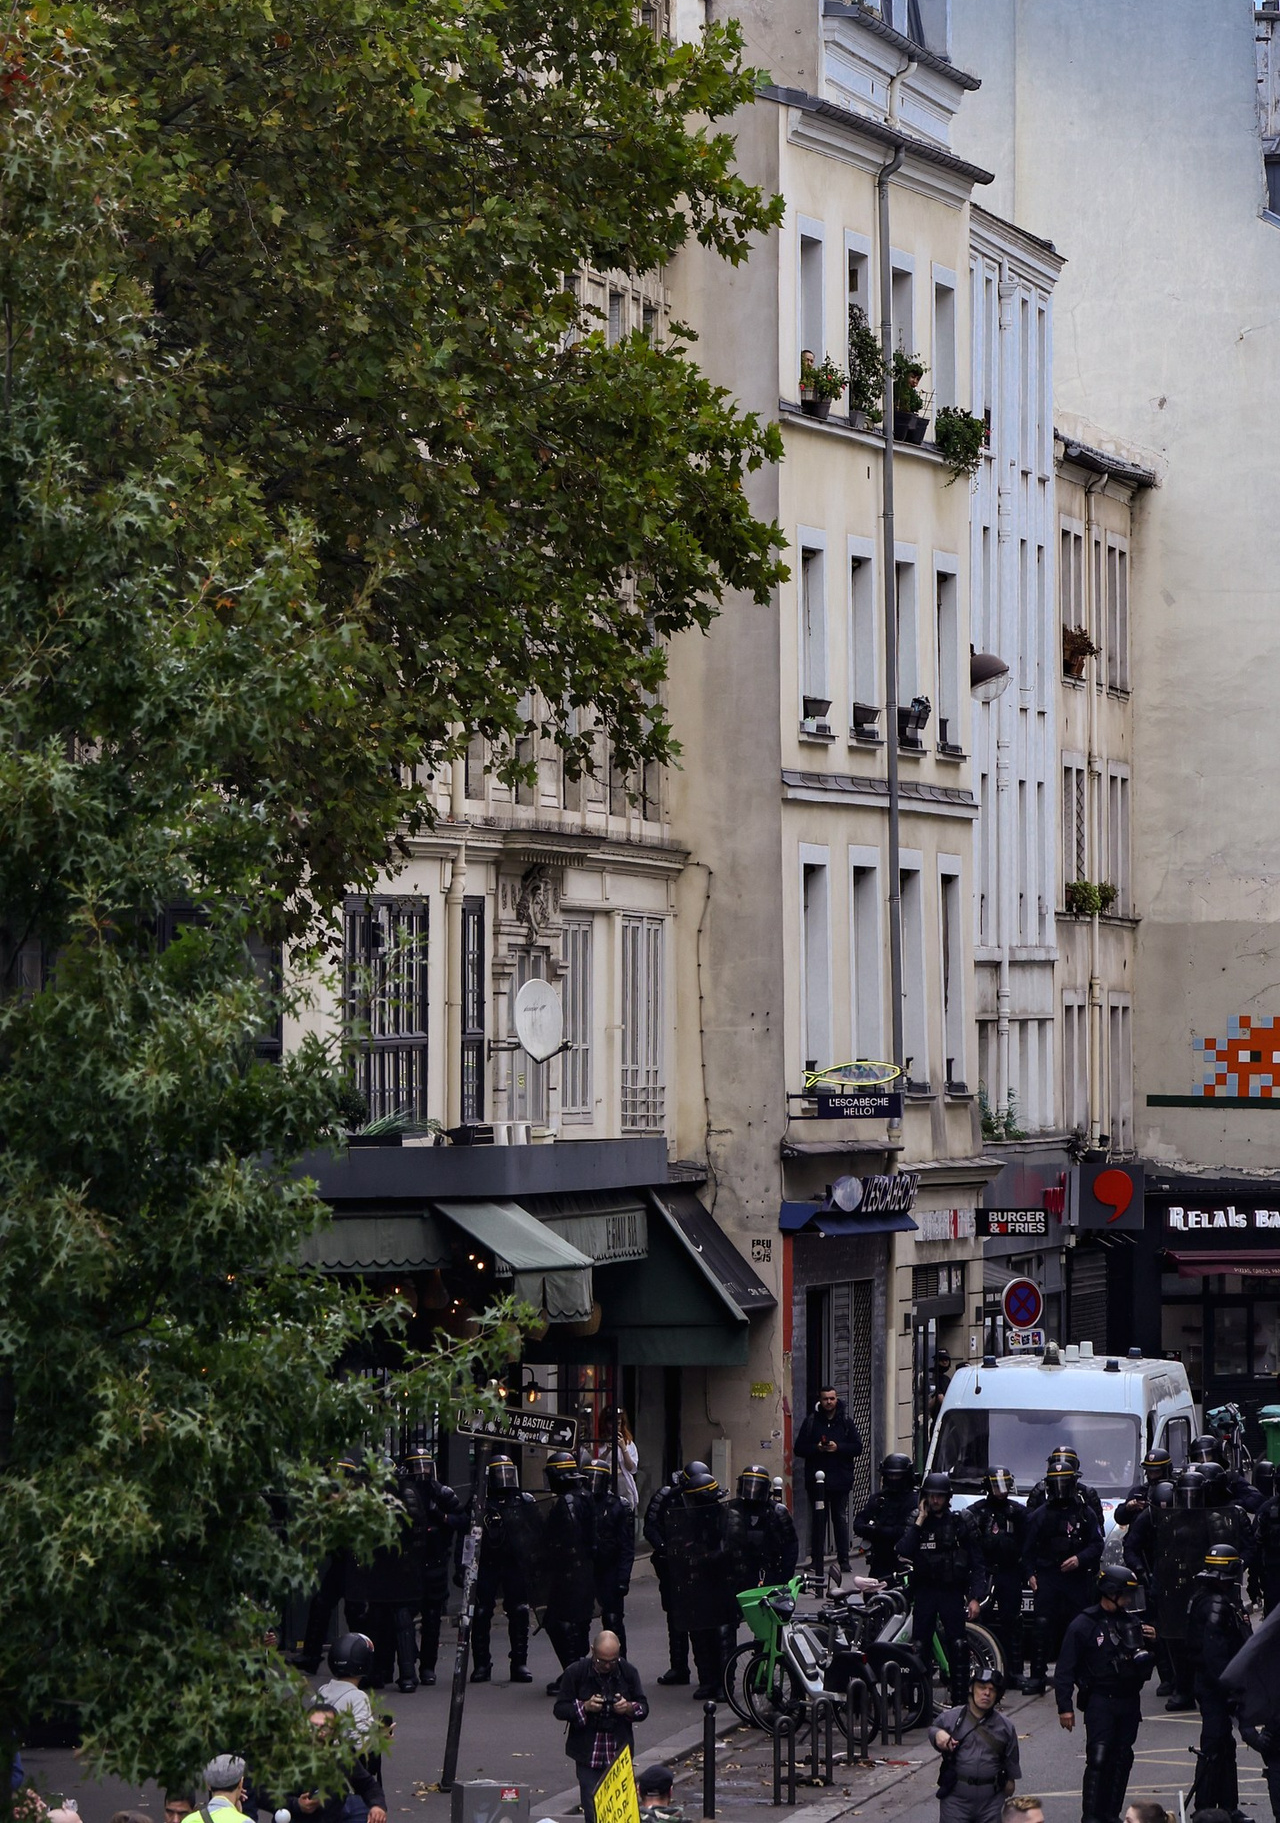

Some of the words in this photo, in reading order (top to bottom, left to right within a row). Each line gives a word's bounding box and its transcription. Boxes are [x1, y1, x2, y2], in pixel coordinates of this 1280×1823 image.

[844, 1107, 874, 1116] HELLO!
[989, 1211, 1045, 1222] BURGER
[1169, 1206, 1247, 1231] RELAIS
[1007, 1222, 1046, 1233] FRIES
[522, 1416, 555, 1431] BASTILLE
